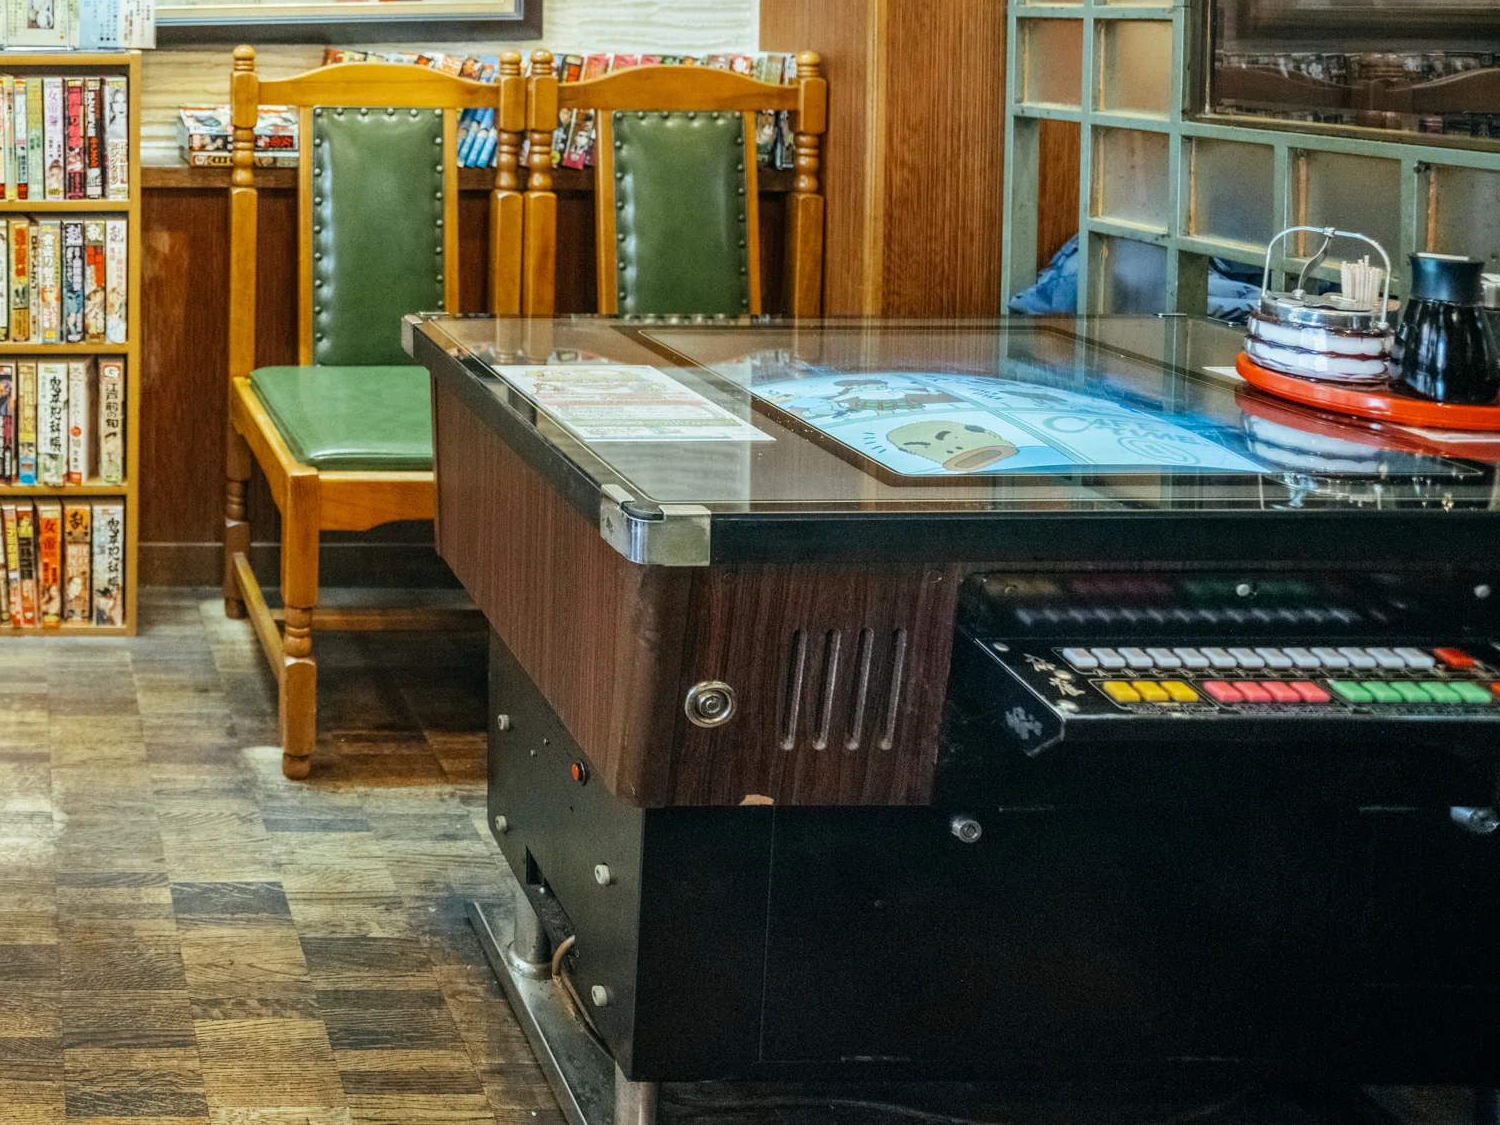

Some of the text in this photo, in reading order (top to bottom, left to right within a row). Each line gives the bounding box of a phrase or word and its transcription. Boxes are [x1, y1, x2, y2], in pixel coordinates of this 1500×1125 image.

[105, 382, 120, 429] 江戸前の旬
[69, 511, 88, 530] 乱
